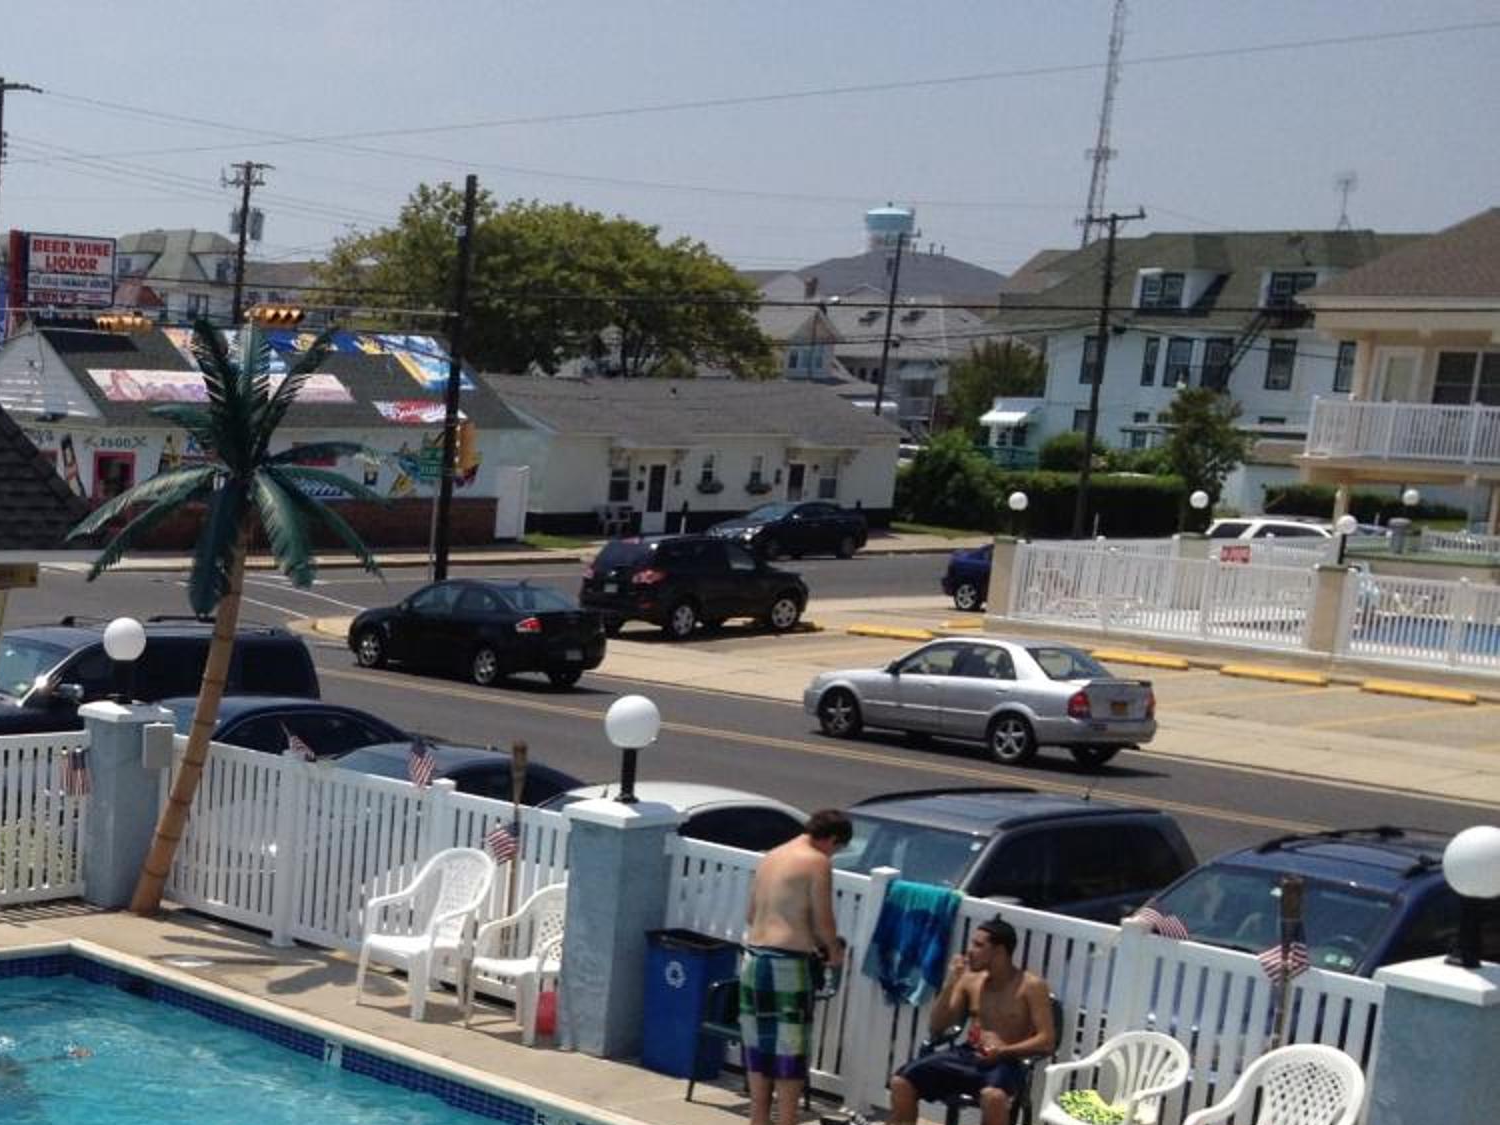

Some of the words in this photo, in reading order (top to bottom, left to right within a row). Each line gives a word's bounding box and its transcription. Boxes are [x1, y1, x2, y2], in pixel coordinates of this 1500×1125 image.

[33, 239, 70, 253] BEER
[74, 242, 111, 257] WINE
[45, 255, 98, 271] LIQUOR
